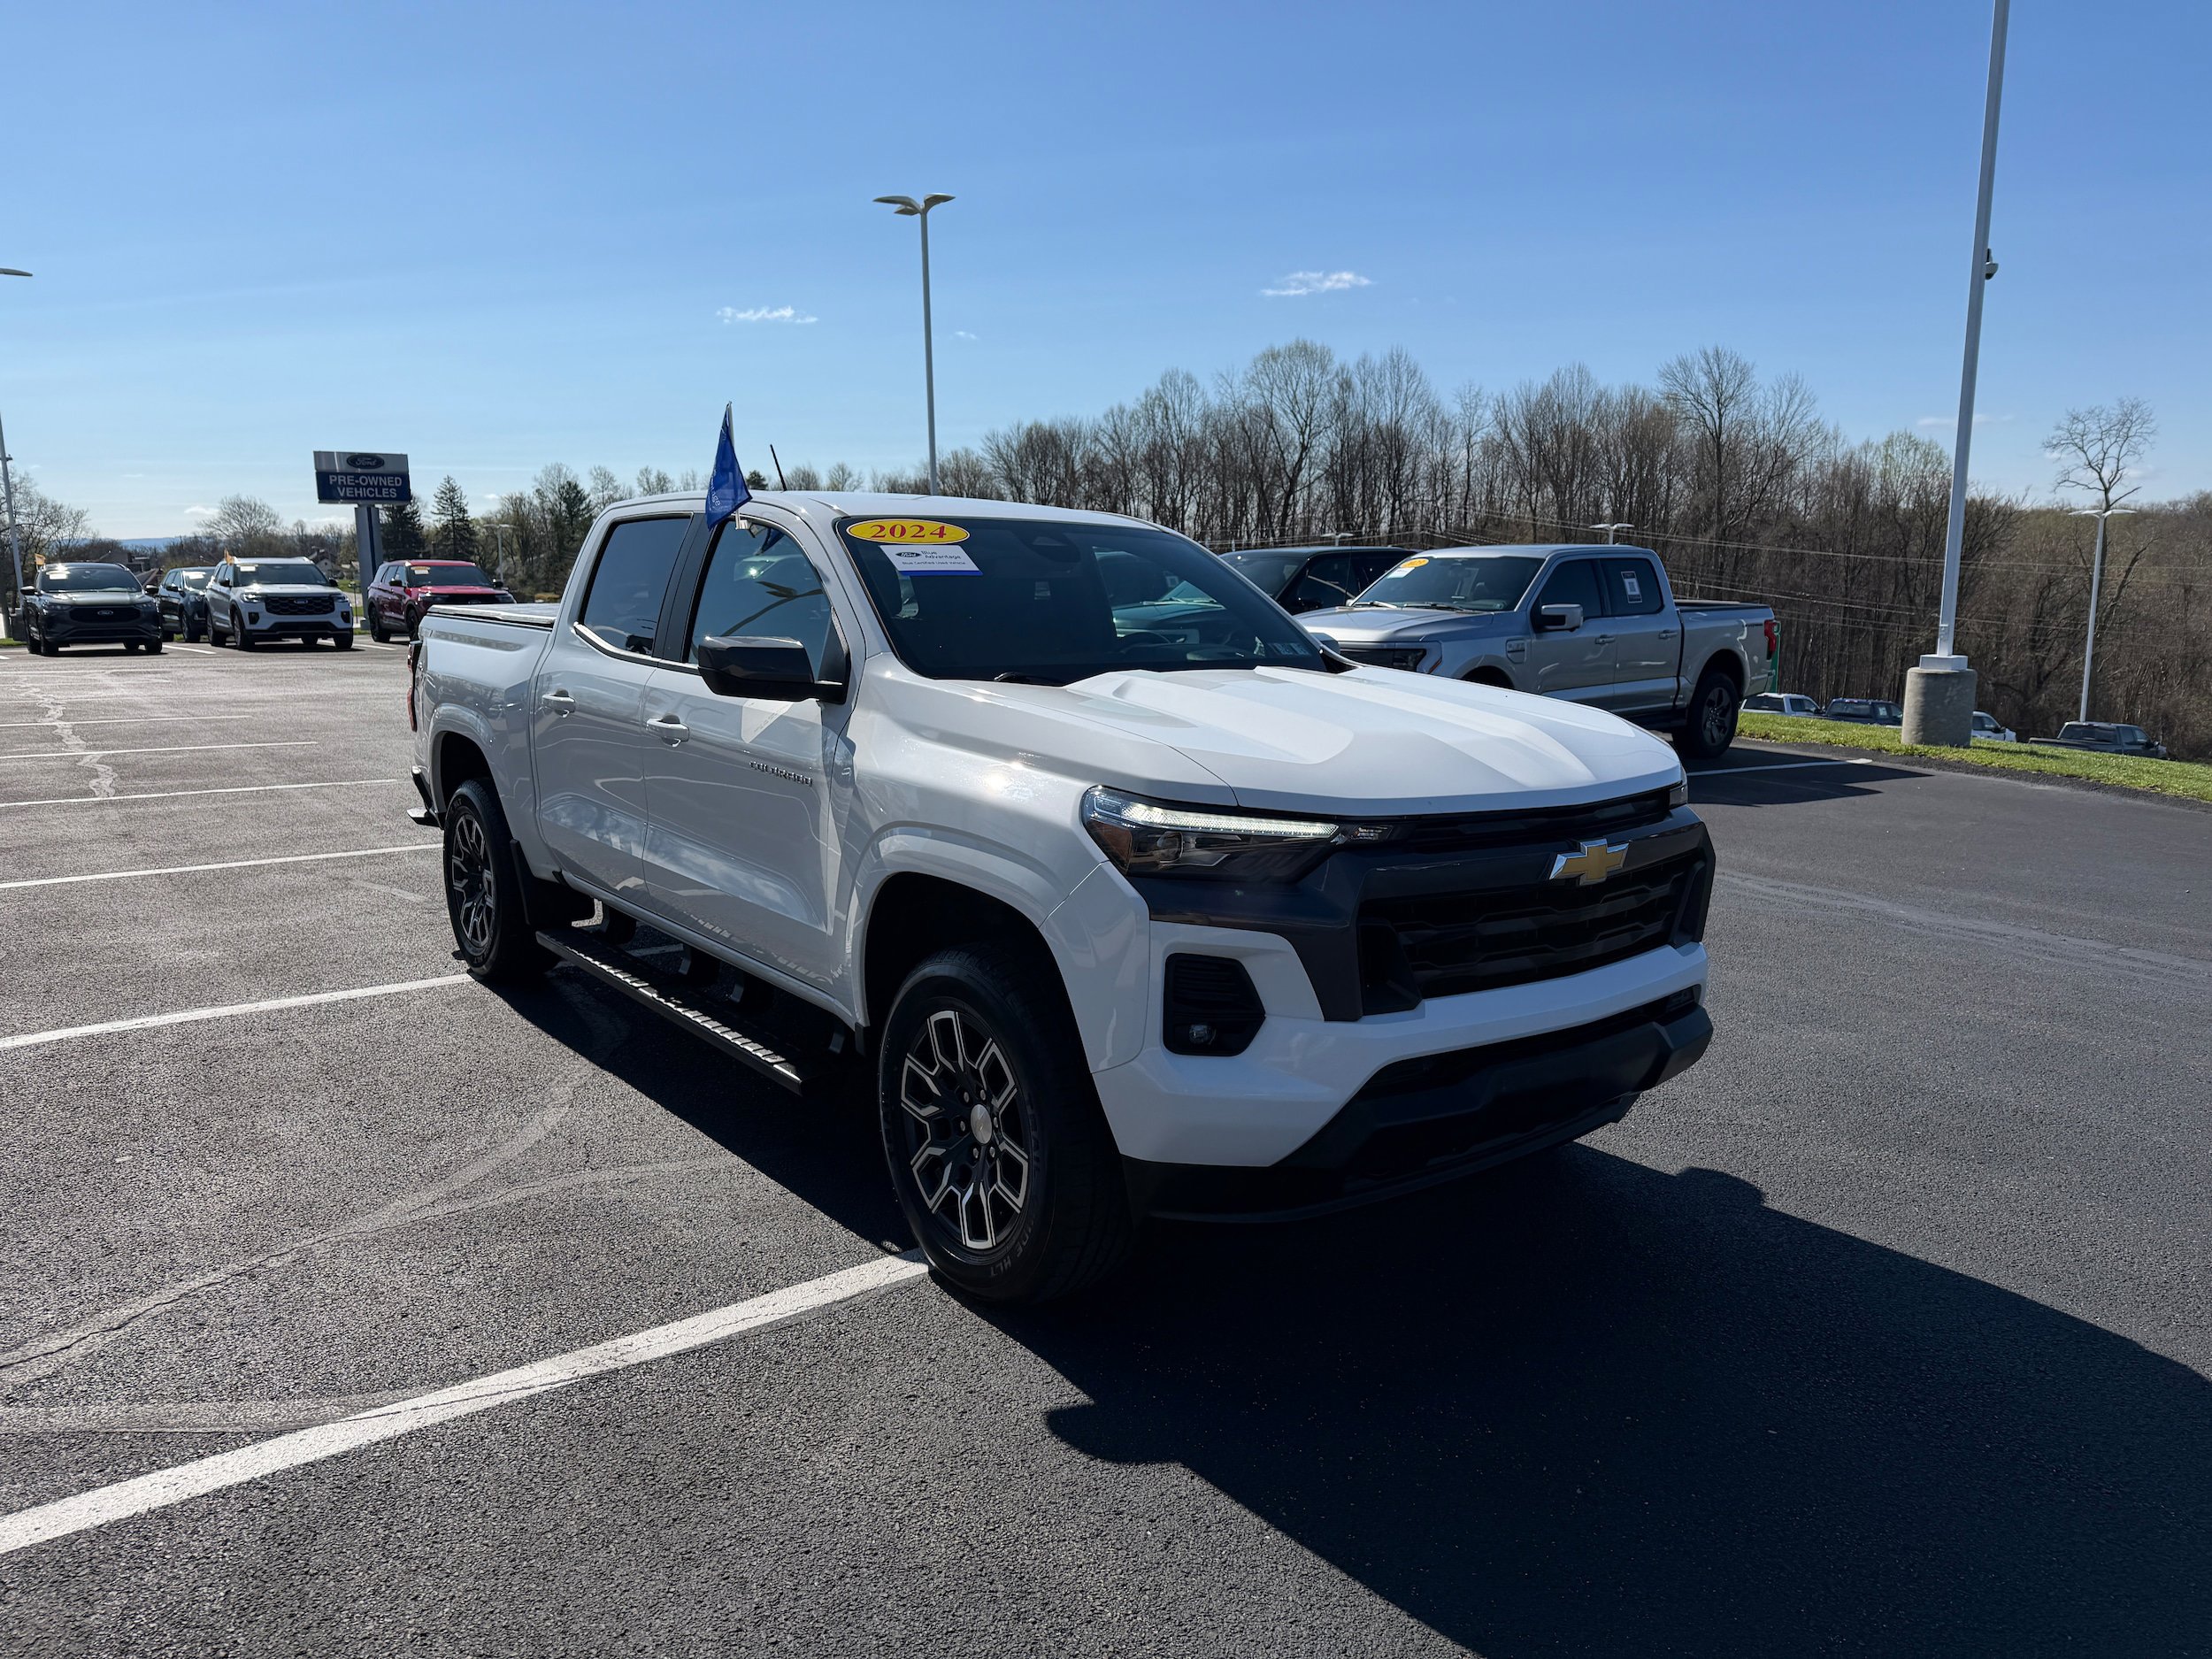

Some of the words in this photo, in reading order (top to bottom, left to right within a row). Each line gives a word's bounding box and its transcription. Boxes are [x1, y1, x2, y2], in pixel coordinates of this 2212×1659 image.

[355, 457, 377, 466] Ford
[329, 475, 402, 486] PRE-OWNED
[337, 488, 397, 498] VEHICLES
[870, 524, 947, 539] 2024
